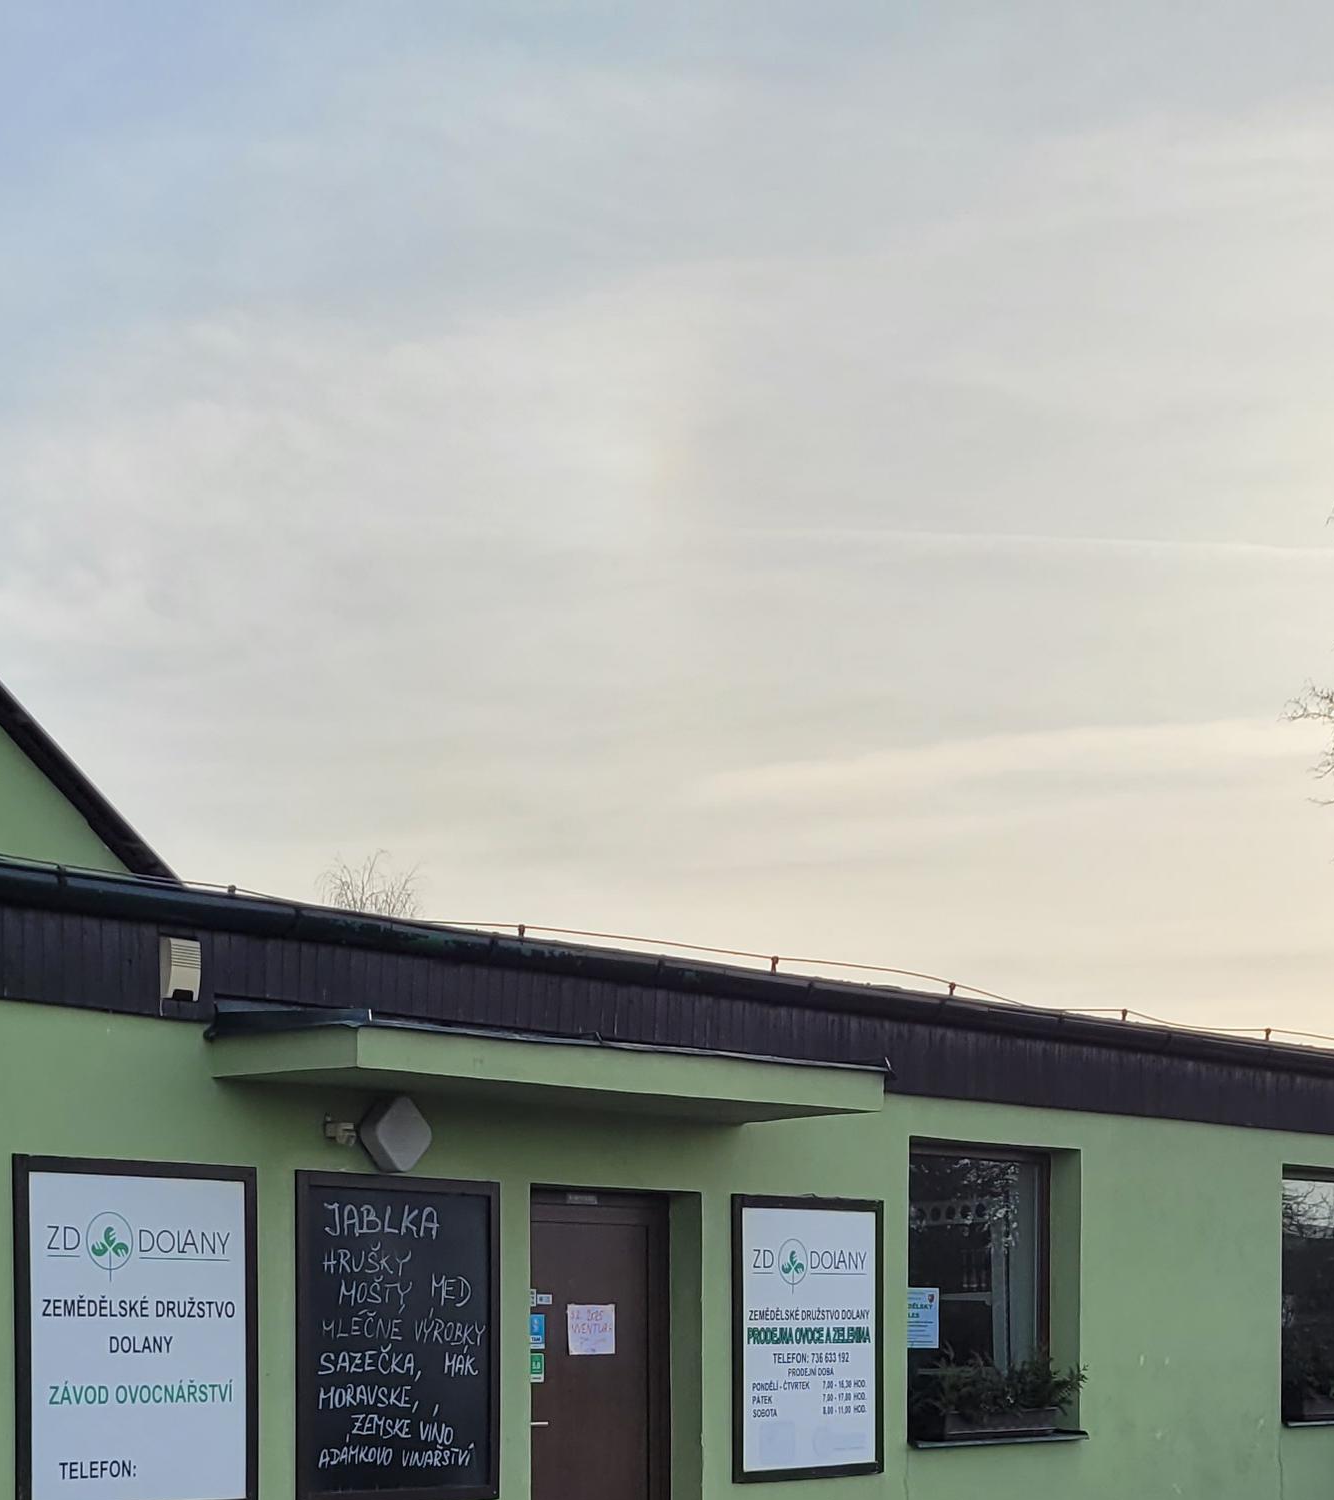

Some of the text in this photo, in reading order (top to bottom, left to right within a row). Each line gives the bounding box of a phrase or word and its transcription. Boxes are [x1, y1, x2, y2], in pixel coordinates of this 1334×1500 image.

[324, 1202, 440, 1240] JABLKA
[47, 1226, 231, 1255] ZD DOLANY
[323, 1241, 412, 1276] HRUŠKY
[753, 1249, 867, 1270] ZD DOLANY
[339, 1273, 472, 1307] MOŠTY MED
[42, 1295, 235, 1318] ZEMĚDĚLSKÉ DRUŽSTVO
[749, 1307, 870, 1321] ZEMĚDĚLSKÉ DRUŽSTVO DOLANY
[415, 1308, 486, 1346] VÝROBKY
[747, 1327, 794, 1344] PRODEJNA
[795, 1327, 824, 1344] OVOCE
[825, 1327, 833, 1343] A
[109, 1336, 173, 1353] DOLANY
[773, 1353, 809, 1364] TELEFON:
[788, 1367, 817, 1377] PRODEJNÍ
[49, 1380, 233, 1404] ZÁVOD OVOCNÁŘSTVÍ
[783, 1380, 810, 1391] ČTVRTEK
[752, 1408, 777, 1418] SOBOTA
[59, 1461, 137, 1479] TELEFON:
